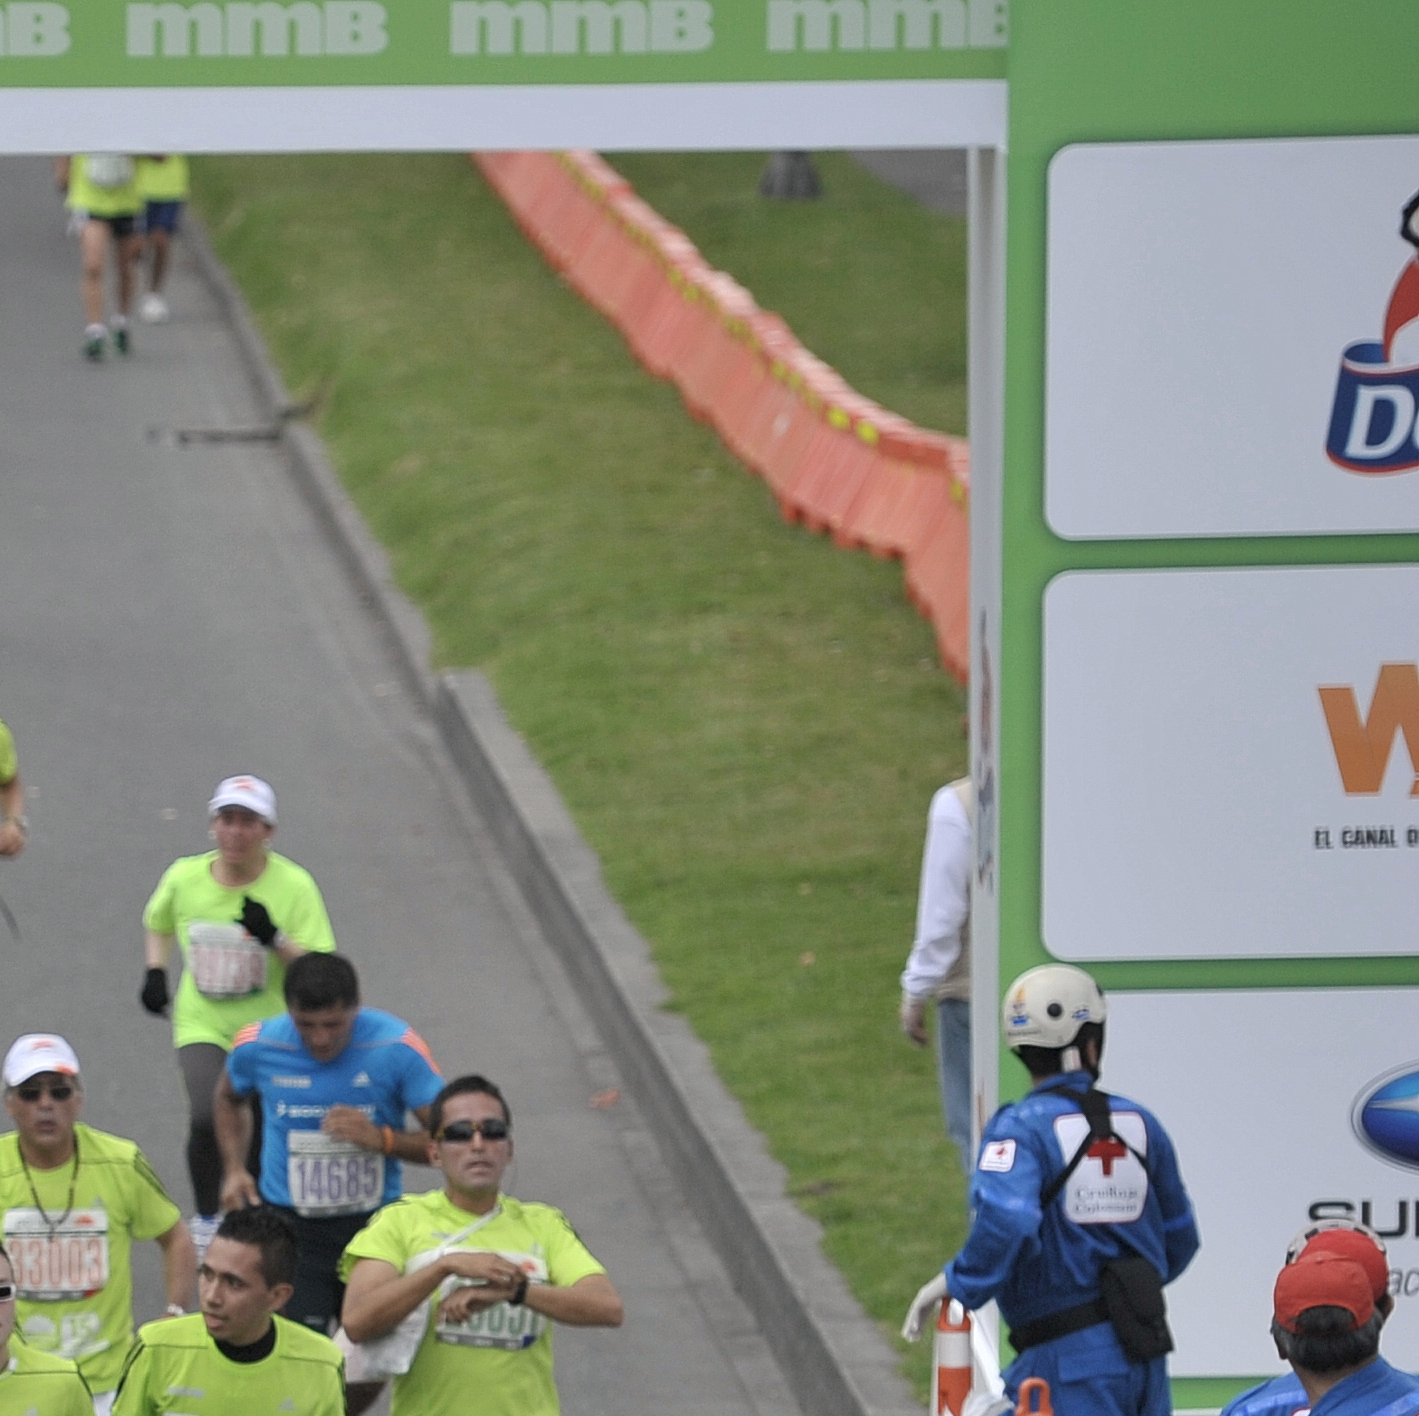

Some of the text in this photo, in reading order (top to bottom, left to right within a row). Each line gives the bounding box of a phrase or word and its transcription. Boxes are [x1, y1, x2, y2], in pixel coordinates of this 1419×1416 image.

[1315, 827, 1396, 848] EL CANAL
[297, 1158, 377, 1203] 14685
